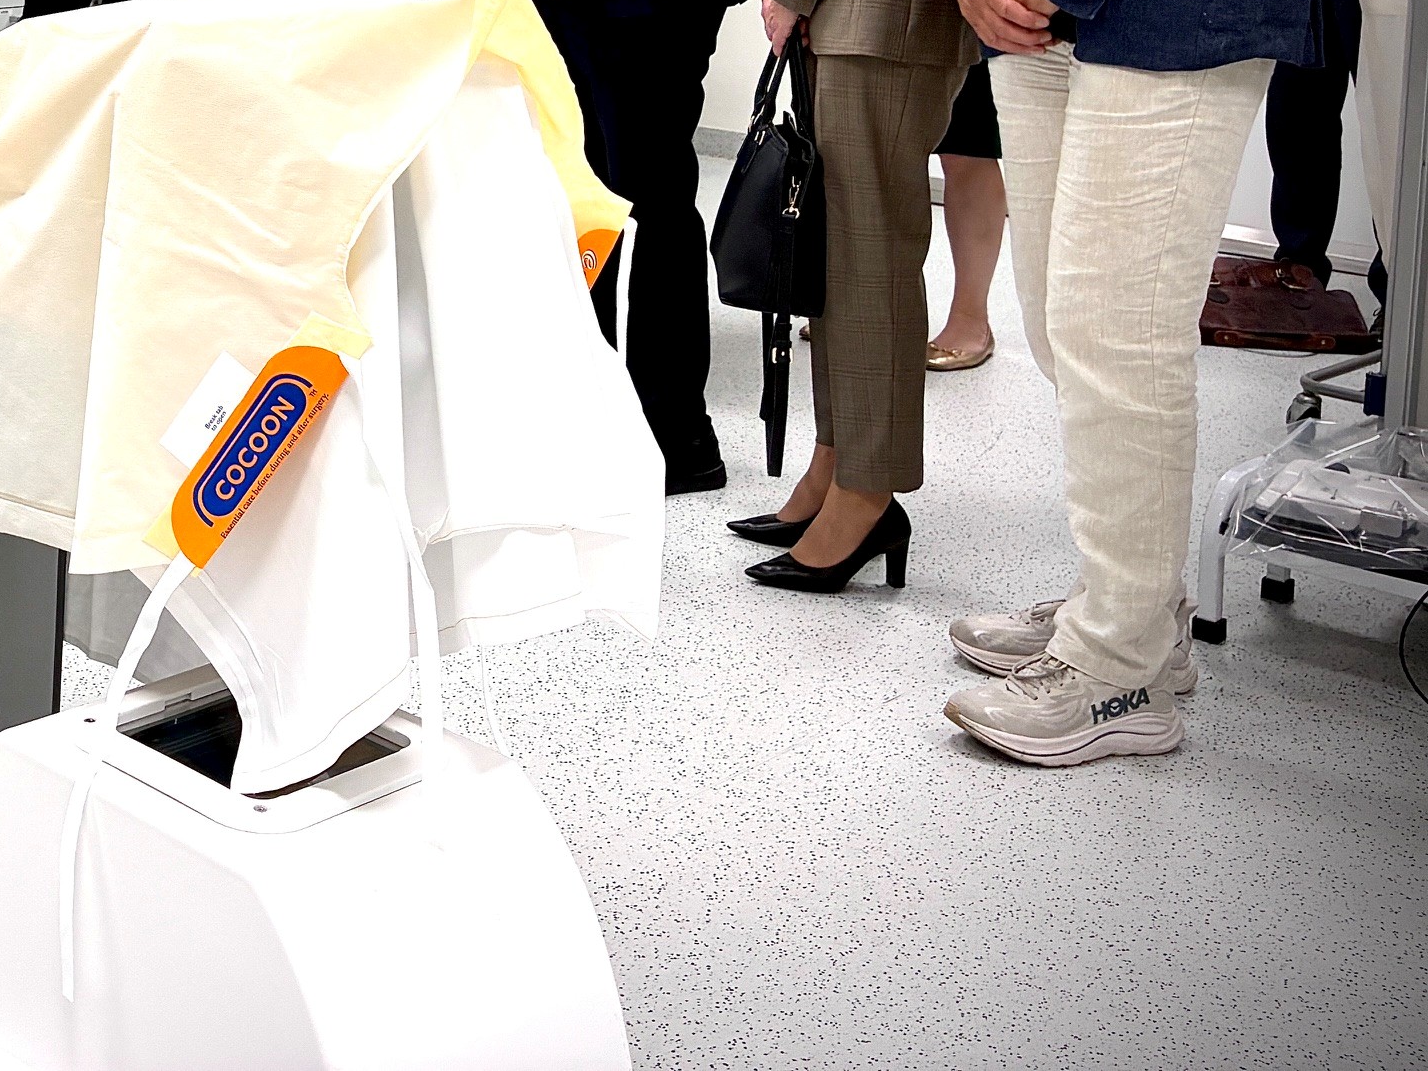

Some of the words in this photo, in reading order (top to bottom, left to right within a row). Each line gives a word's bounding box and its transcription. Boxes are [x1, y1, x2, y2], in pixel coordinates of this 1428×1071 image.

[204, 414, 217, 429] Break
[215, 405, 223, 414] tab
[216, 411, 226, 425] open
[215, 395, 295, 501] COCOON
[220, 508, 245, 539] Essential
[243, 495, 256, 510] care
[251, 472, 273, 496] before,
[269, 447, 291, 472] during
[286, 433, 299, 449] and
[296, 417, 310, 436] after
[308, 393, 329, 420] surgery.
[1091, 687, 1151, 725] HOKA
